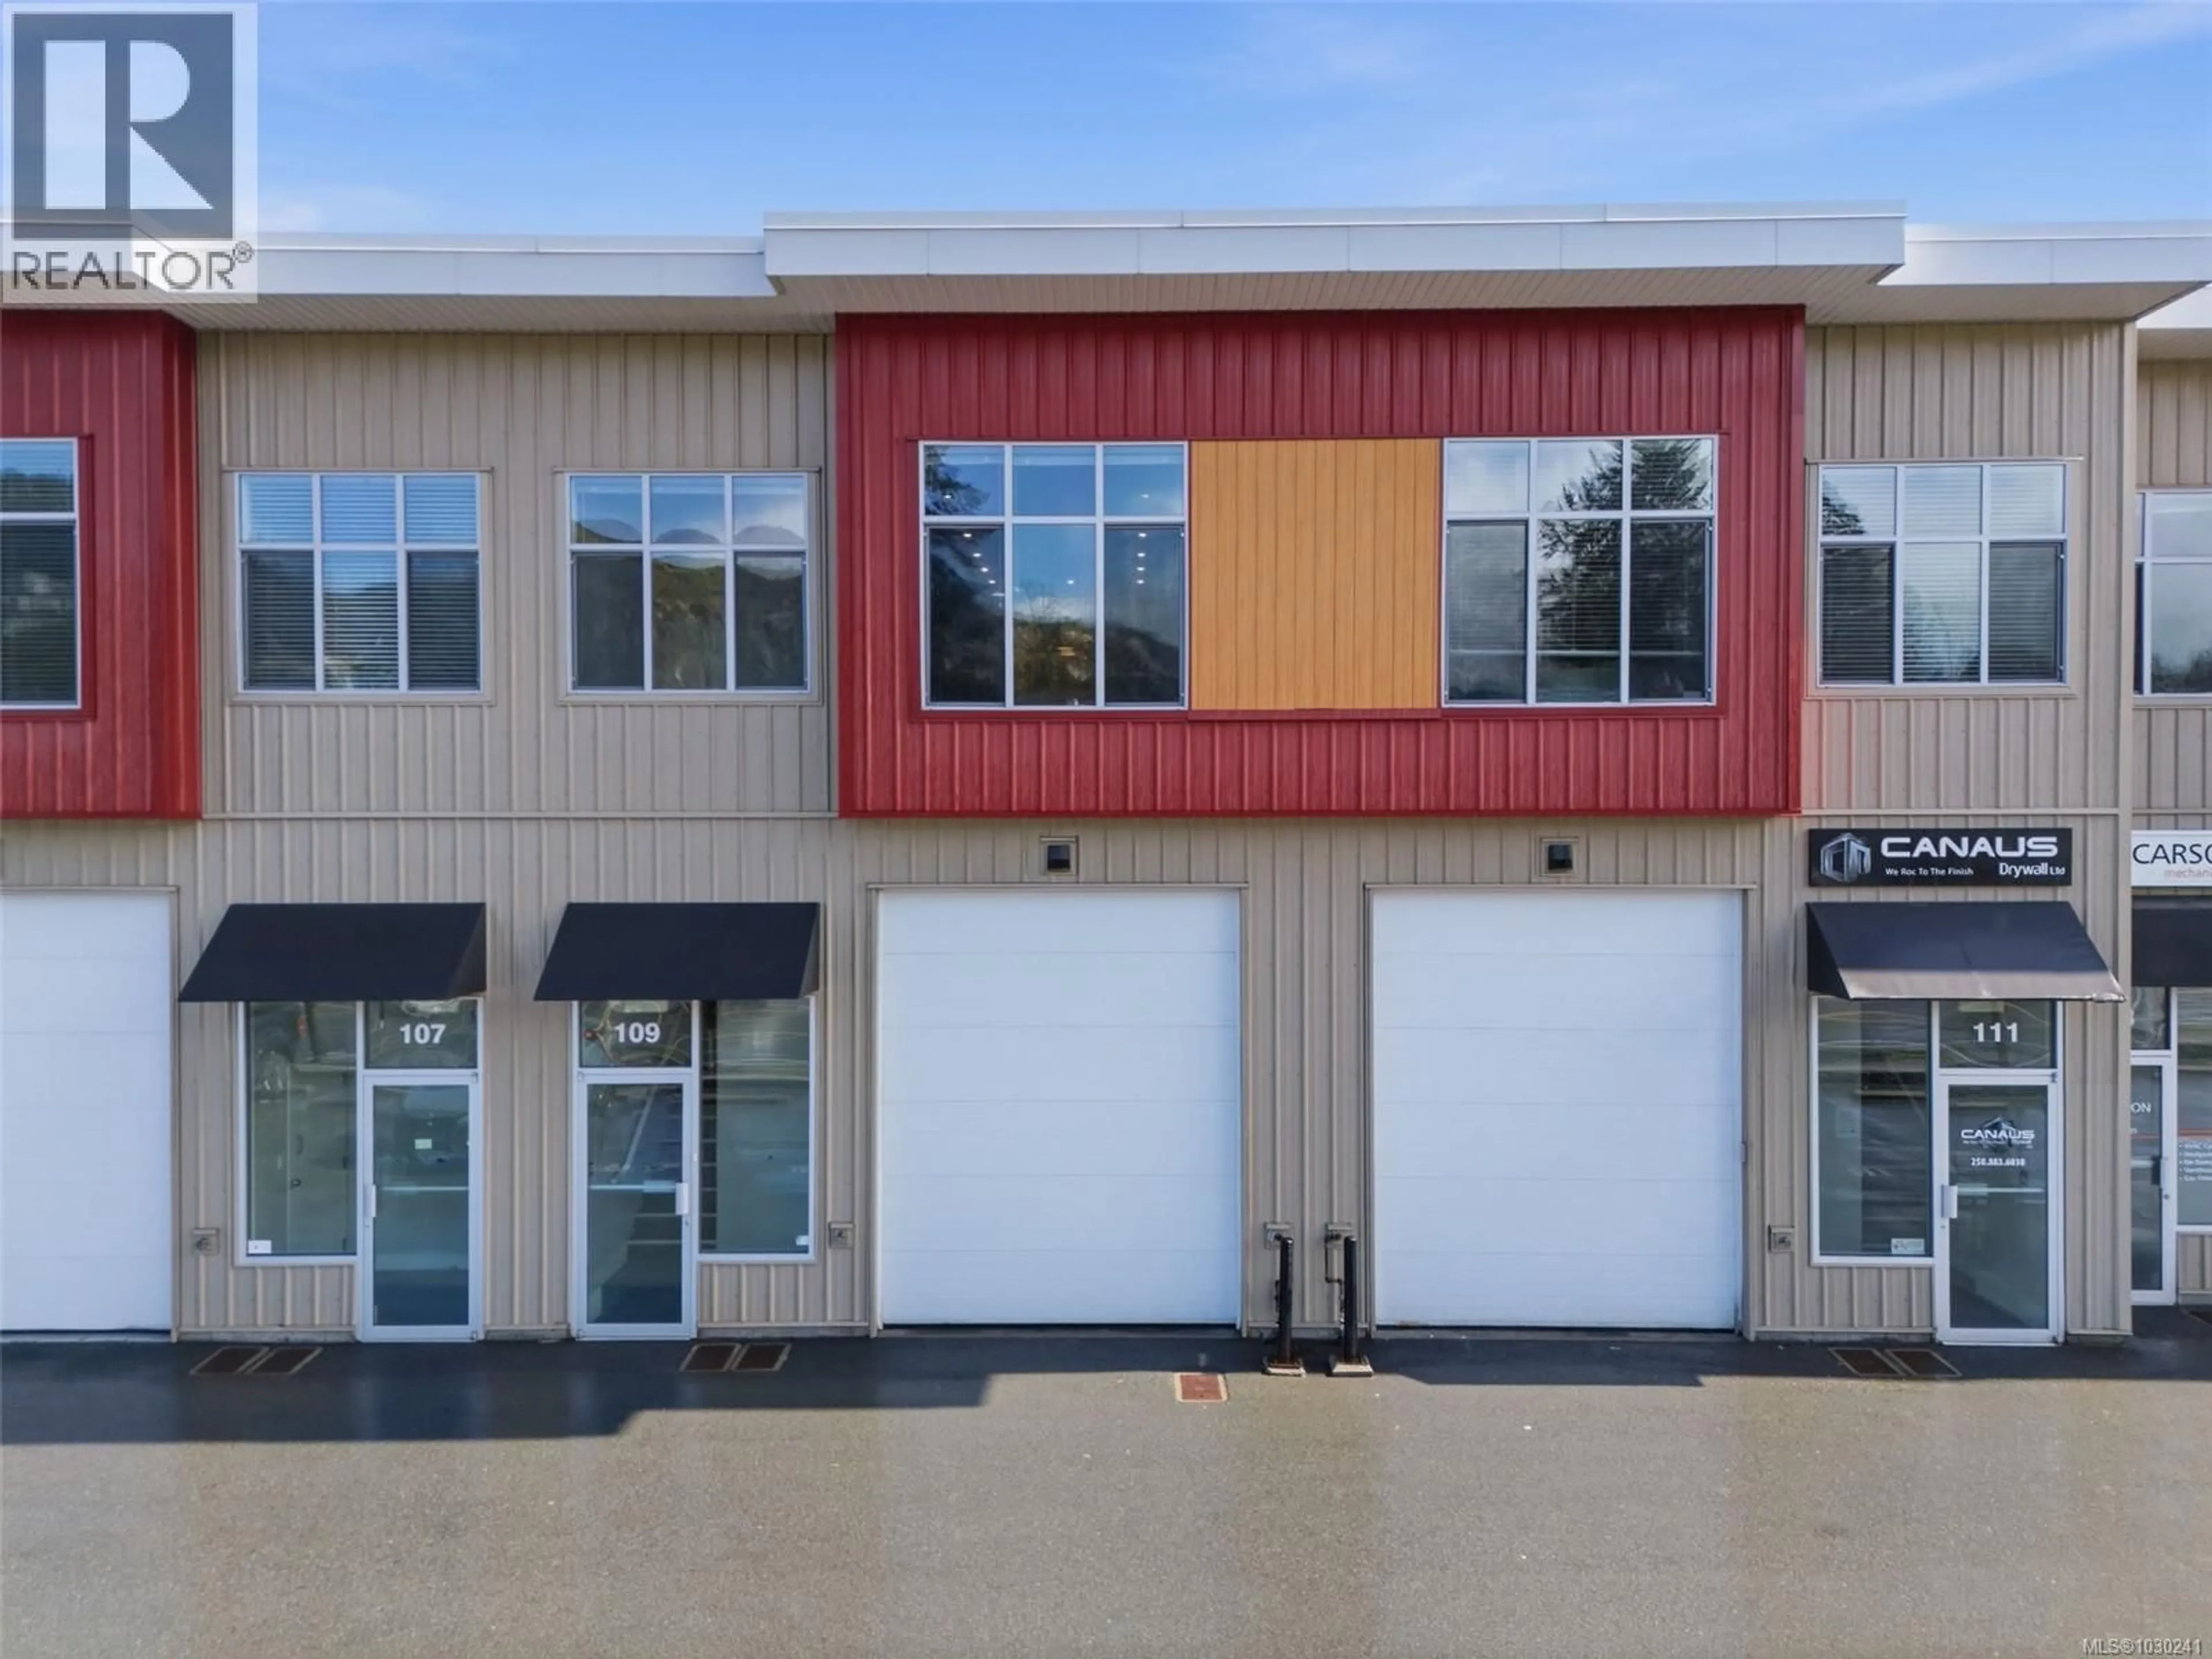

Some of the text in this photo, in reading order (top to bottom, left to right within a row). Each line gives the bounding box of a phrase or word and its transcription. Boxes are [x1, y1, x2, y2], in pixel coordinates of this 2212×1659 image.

[1880, 836, 2058, 858] CANAUS
[1885, 868, 1974, 876] We Roc To The Finish
[1998, 862, 2066, 878] Drywall Ltd
[399, 1023, 447, 1045] 107
[613, 1022, 661, 1044] 109
[1972, 1022, 2018, 1043] 111
[1961, 1129, 2036, 1139] CANAUS
